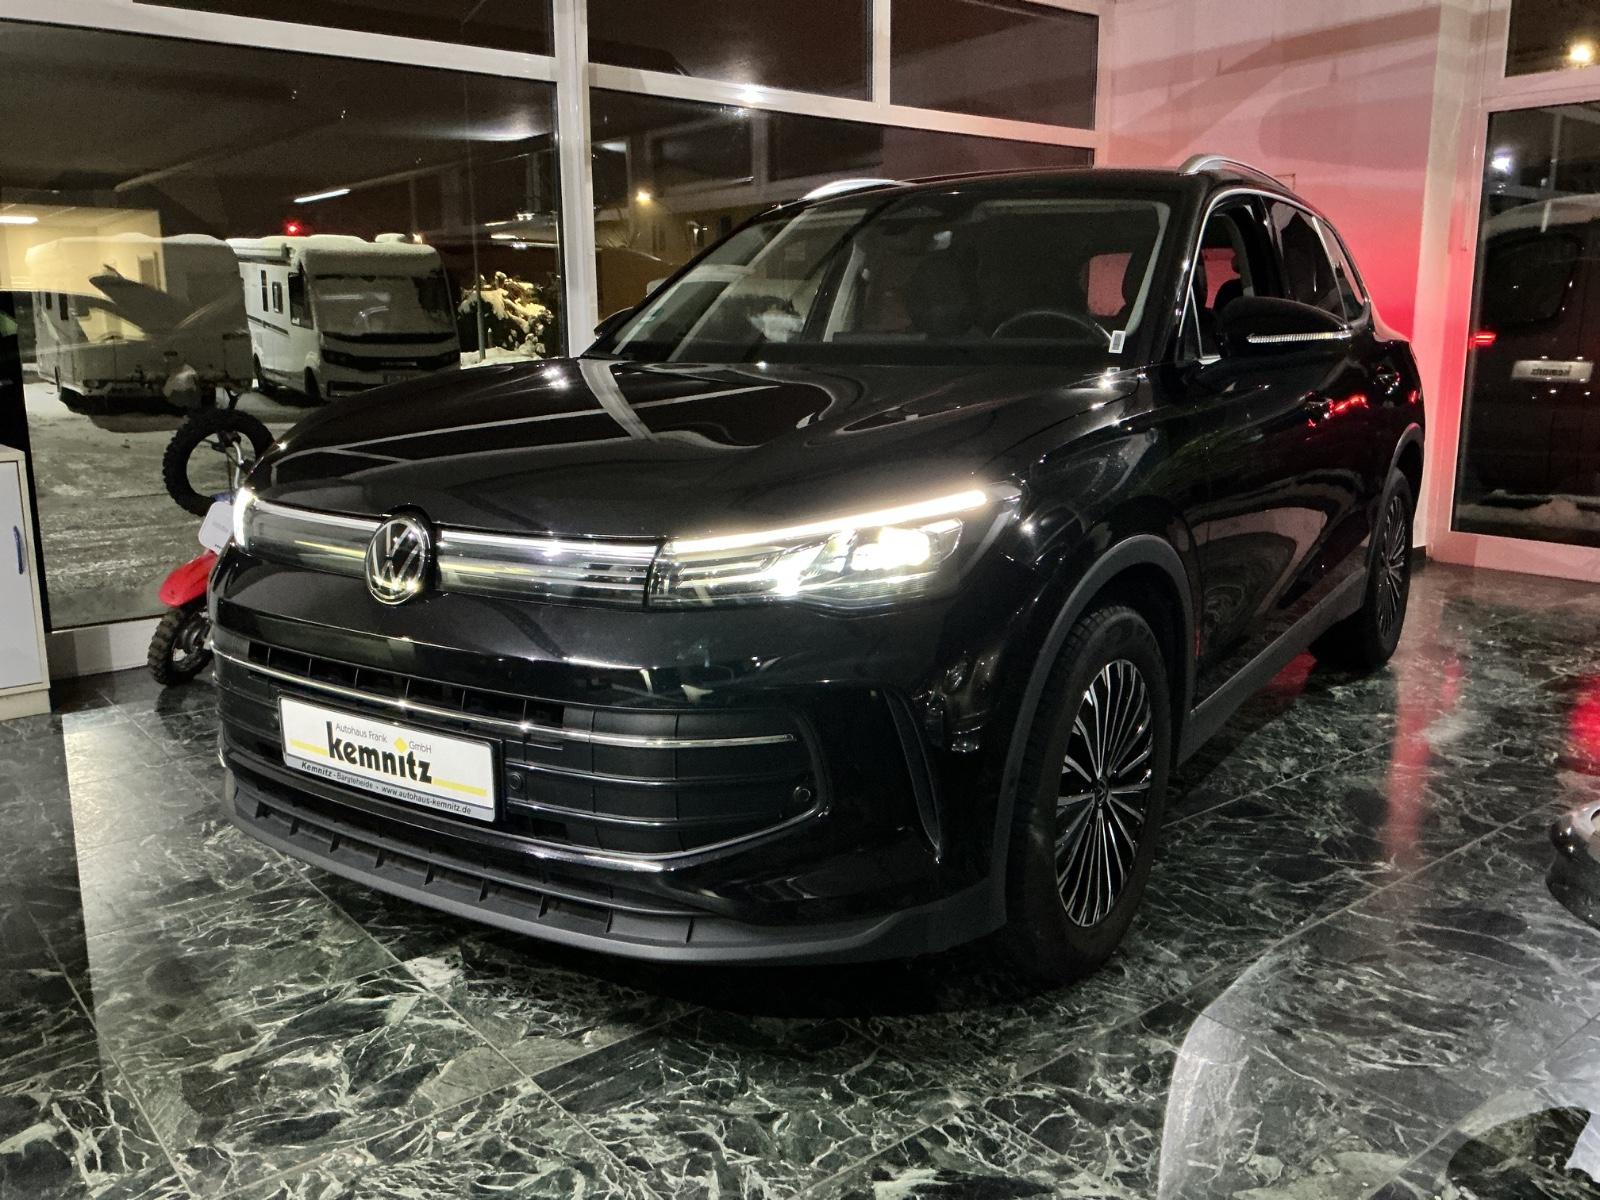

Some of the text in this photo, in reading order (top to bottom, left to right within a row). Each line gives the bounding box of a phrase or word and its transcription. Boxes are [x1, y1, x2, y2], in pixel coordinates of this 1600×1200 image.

[326, 720, 432, 784] kemnitz
[336, 723, 432, 754] Autohaus Frank GmbH
[301, 761, 332, 777] Kemnitz
[381, 786, 471, 815] www.autohaus-kemnitz.de
